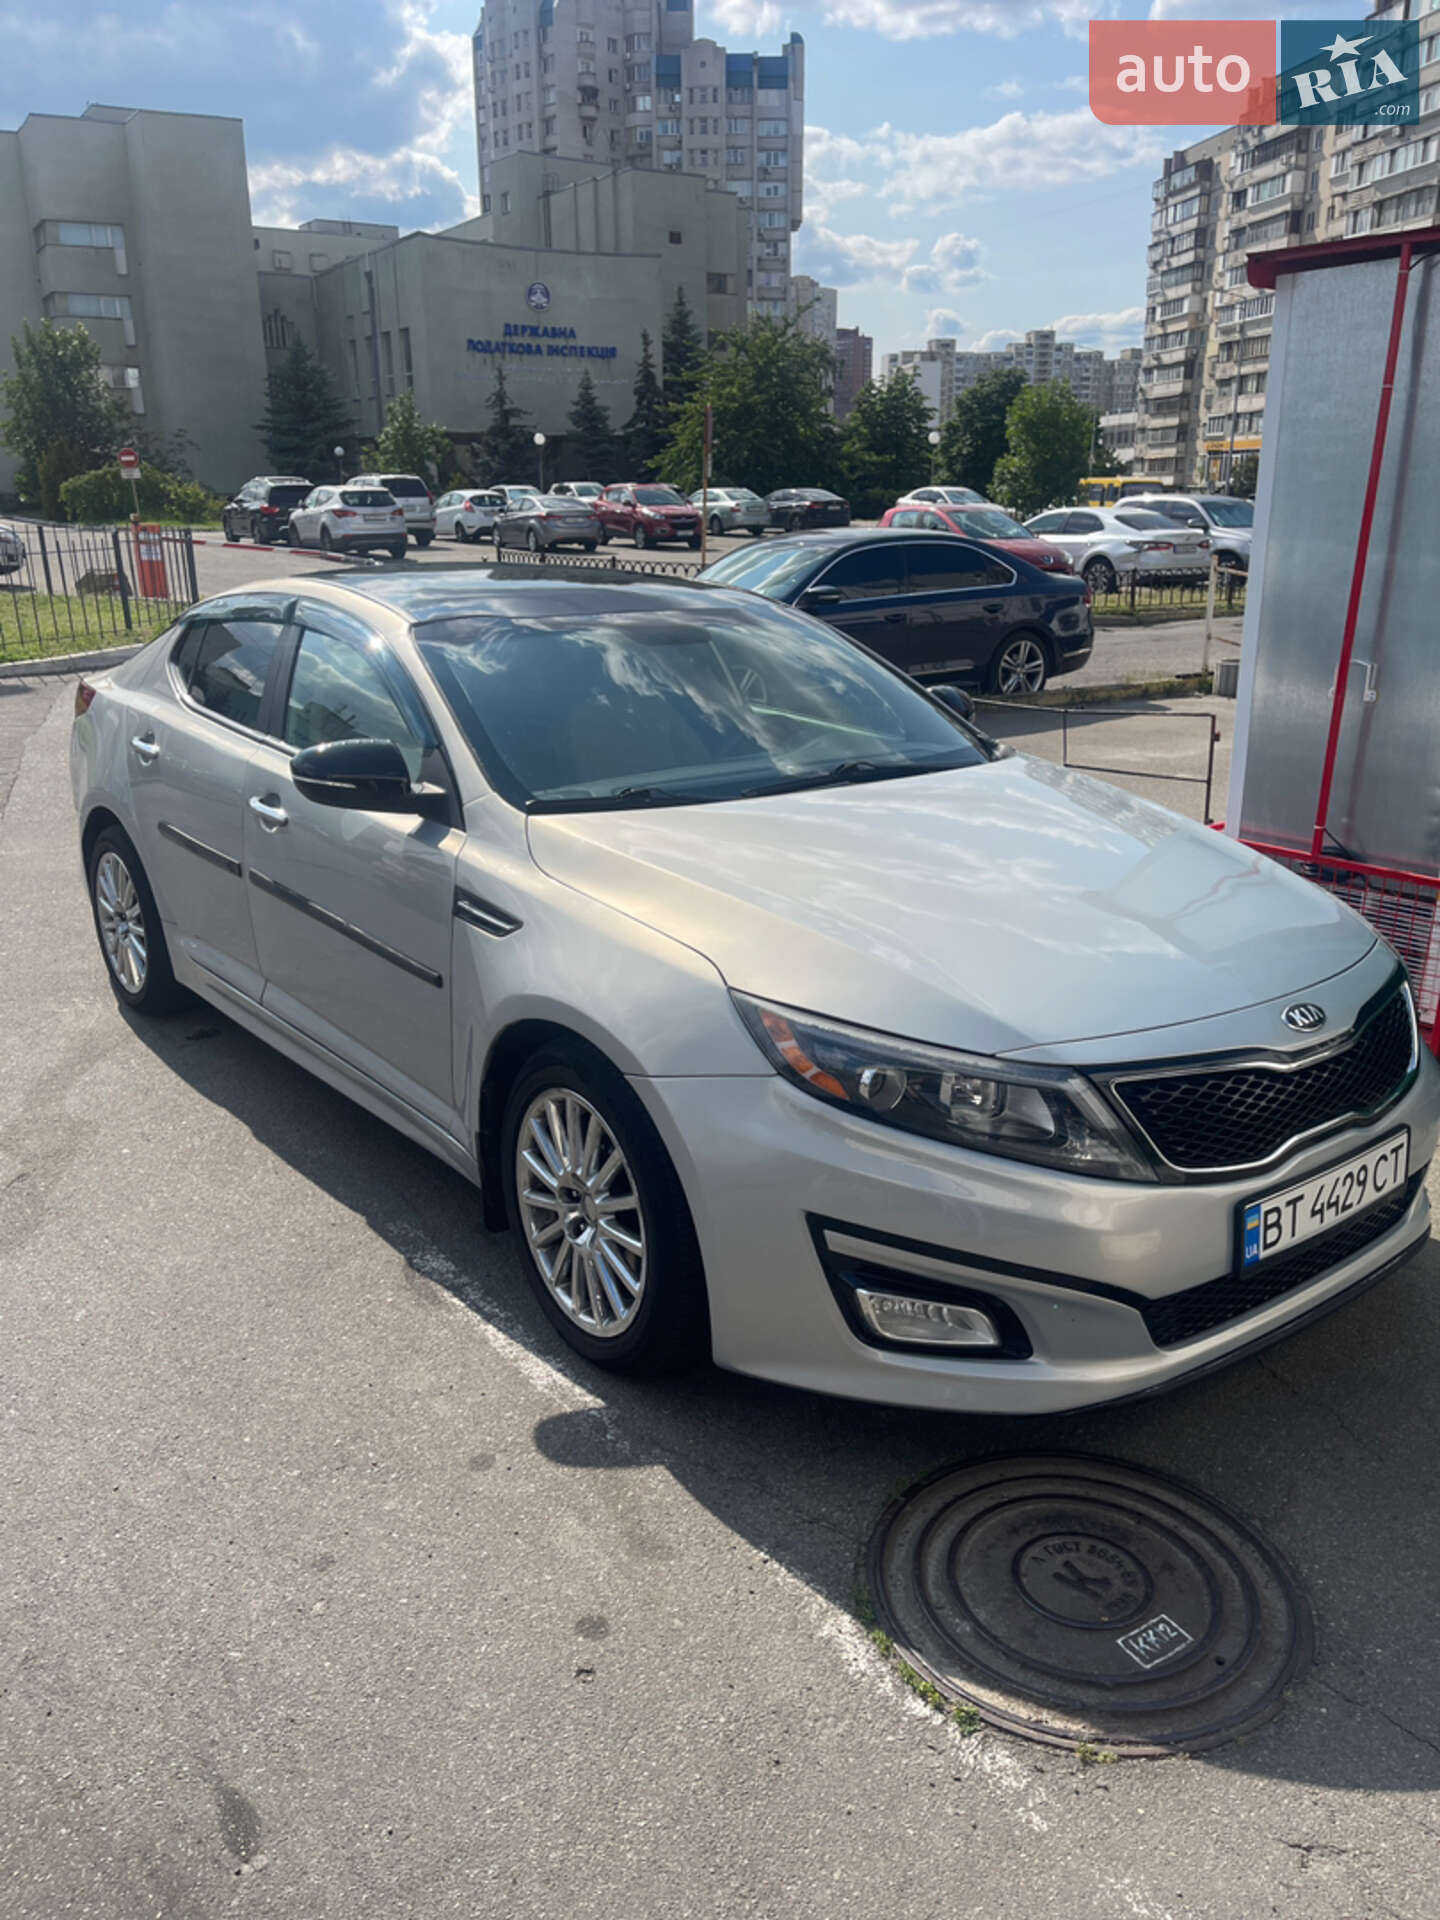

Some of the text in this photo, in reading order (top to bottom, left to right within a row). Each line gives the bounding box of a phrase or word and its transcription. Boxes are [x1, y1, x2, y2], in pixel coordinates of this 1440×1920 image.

[502, 322, 577, 340] ДЕРЖАВНА
[466, 338, 618, 361] ПОДАТКОВА ІНСПЕКЦІЯ
[1288, 1004, 1325, 1027] KIA
[1262, 1142, 1405, 1251] BT 4429 CT
[1245, 1243, 1258, 1259] UA
